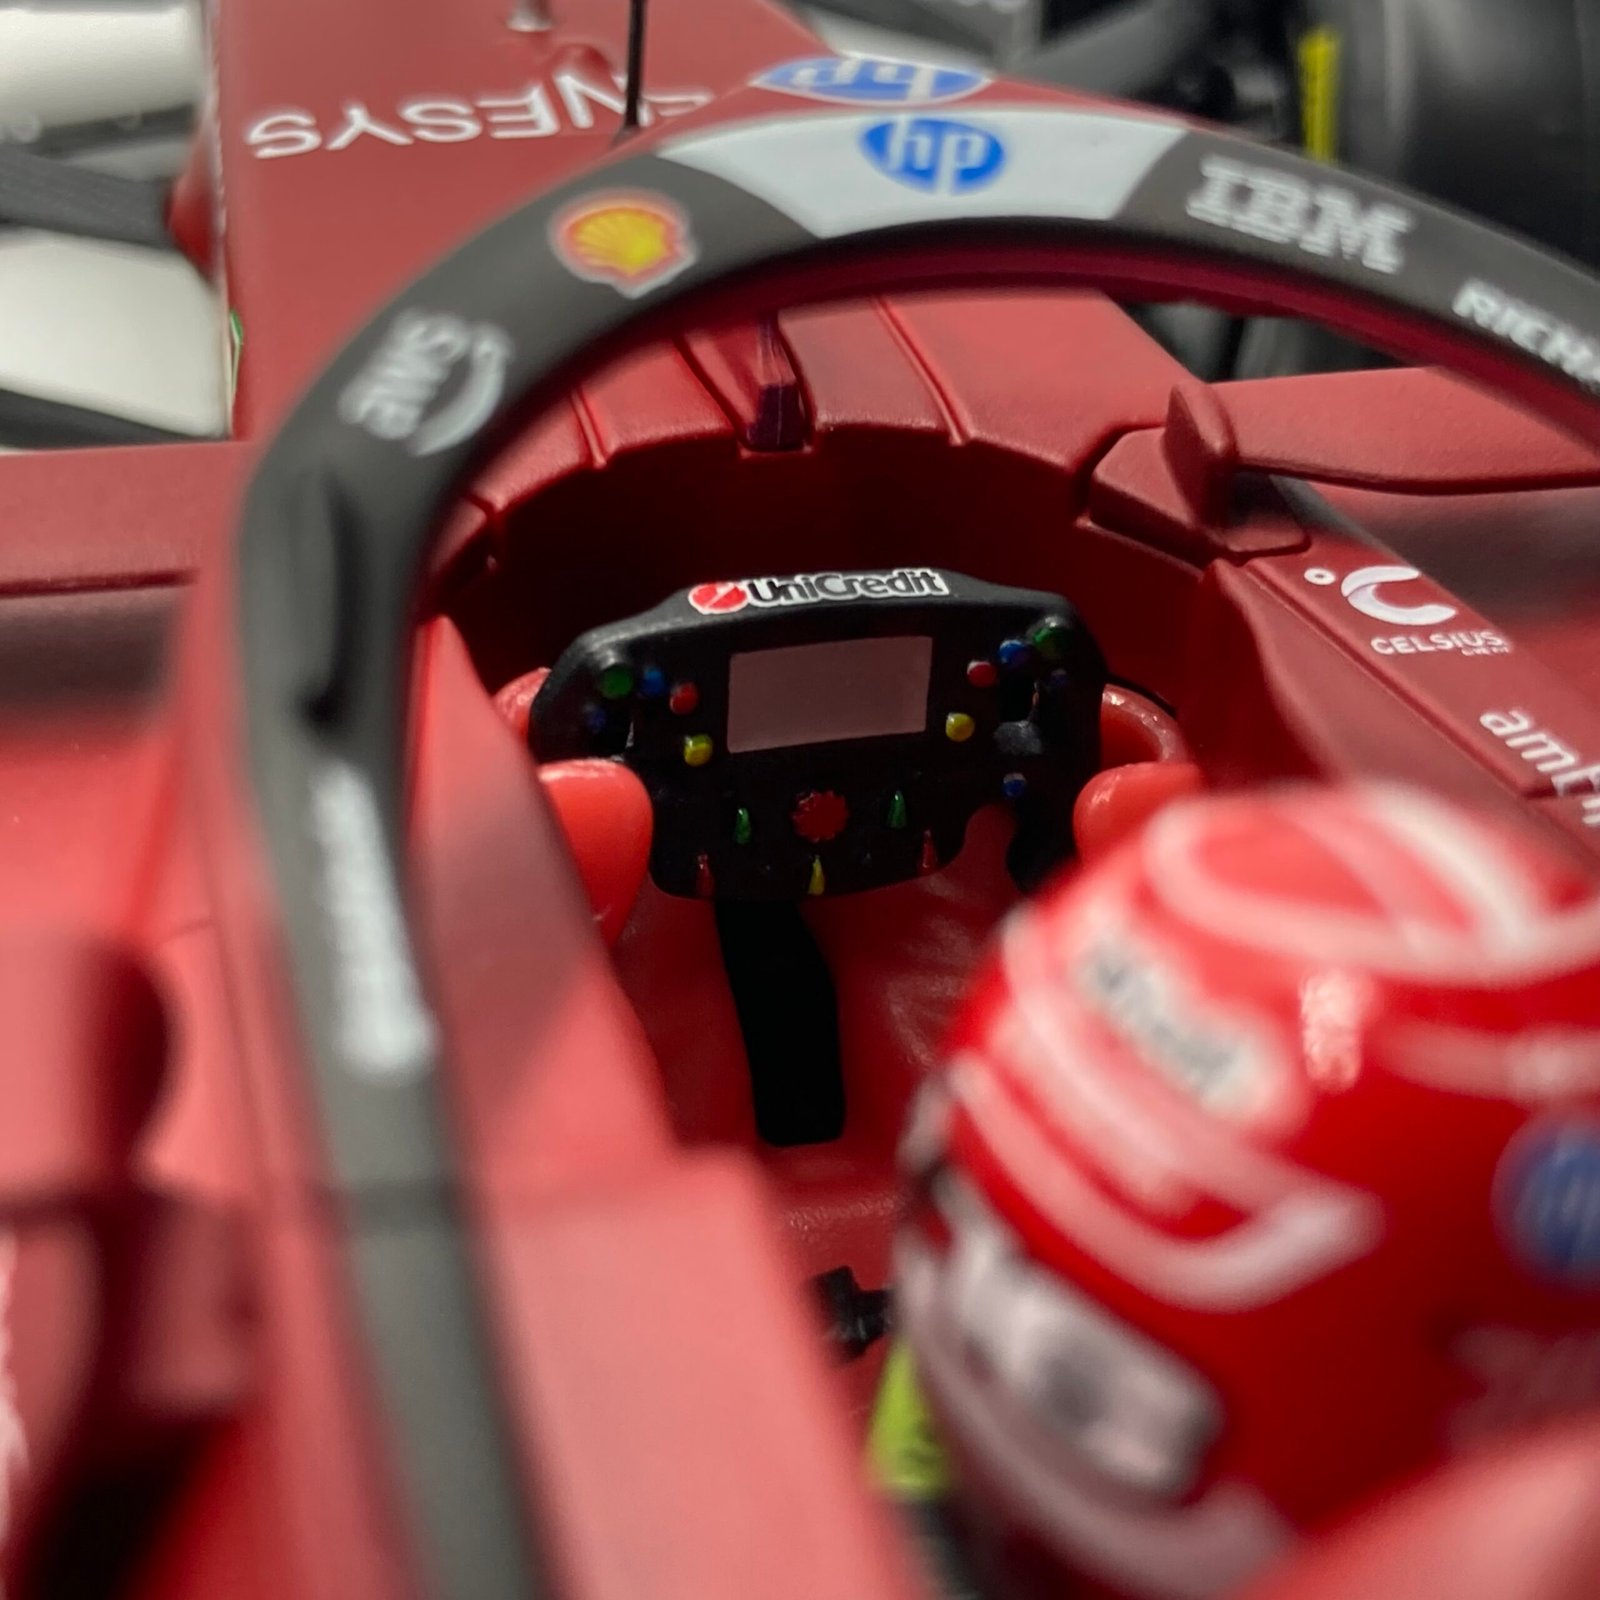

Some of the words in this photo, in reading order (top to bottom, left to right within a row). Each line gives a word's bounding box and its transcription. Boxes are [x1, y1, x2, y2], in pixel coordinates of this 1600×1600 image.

[886, 114, 990, 195] hp
[1188, 158, 1411, 274] IBM
[1453, 281, 1600, 386] RICH
[747, 569, 949, 606] UniCredit
[1370, 630, 1504, 655] CELSIUS
